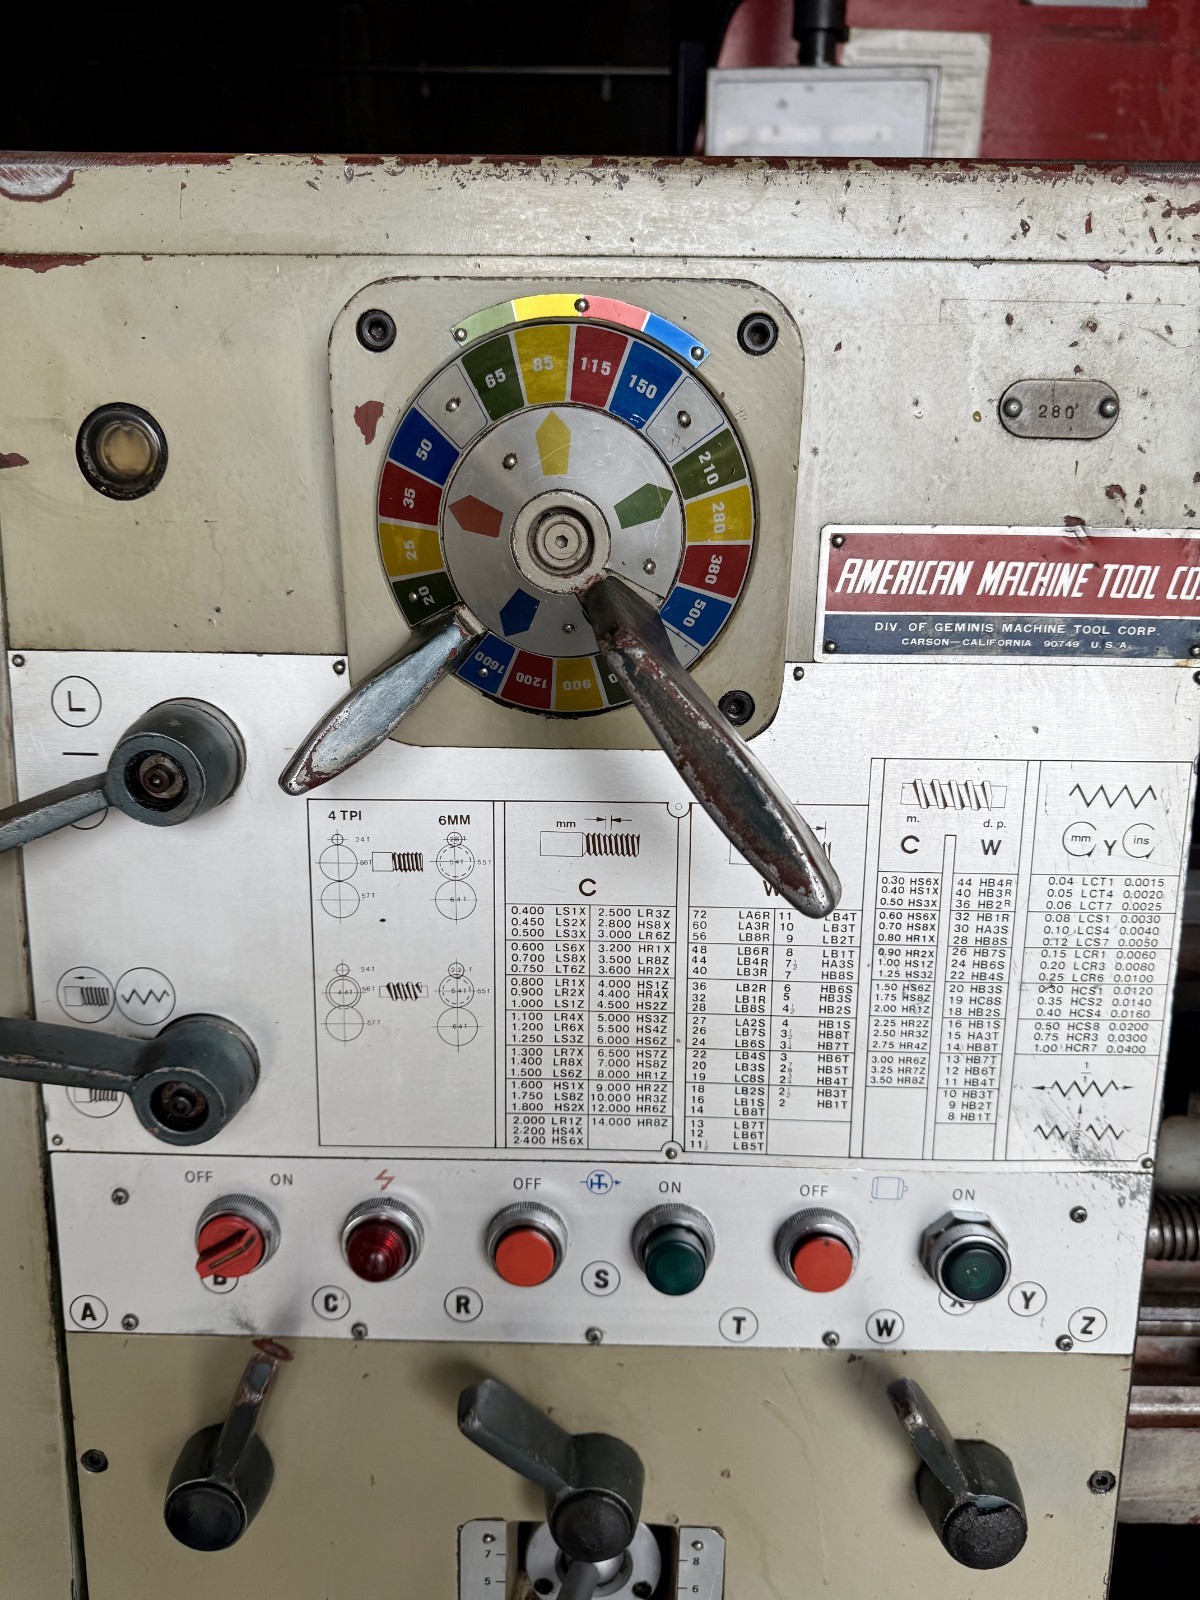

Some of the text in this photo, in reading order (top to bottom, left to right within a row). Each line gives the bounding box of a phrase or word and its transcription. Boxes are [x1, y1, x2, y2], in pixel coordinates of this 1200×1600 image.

[533, 356, 554, 371] 85
[581, 357, 612, 376] 115
[485, 369, 506, 388] 65
[628, 374, 658, 399] 150
[1038, 404, 1074, 419] 280
[416, 438, 433, 462] 50
[699, 451, 719, 486] 210
[403, 488, 416, 509] 35
[712, 501, 725, 534] 280
[403, 540, 417, 560] 25
[705, 554, 722, 584] 380
[834, 558, 975, 595] AMERICAN
[976, 561, 1094, 597] MACHINE
[1097, 564, 1160, 599] TOOL
[418, 586, 435, 606] 20
[683, 598, 706, 627] 500
[875, 622, 1160, 635] DIV. OF GEMINIS MACHINE TOOL CORP.
[474, 651, 506, 674] 1600
[516, 672, 547, 689] 1200
[563, 679, 591, 690] 900
[68, 690, 86, 712] L
[328, 811, 362, 821] 4 TPI
[439, 815, 470, 825] 6MM
[556, 820, 576, 828] mm
[901, 835, 920, 854] C
[1133, 835, 1149, 845] ins
[981, 839, 1002, 855] W
[1104, 840, 1117, 856] Y
[882, 877, 905, 885] 0.30
[980, 879, 1012, 887] HB4R
[1048, 876, 1164, 887] 0.04 LCT1 0.0015
[578, 878, 597, 897] C
[511, 907, 586, 915] 0.400 LS1X
[599, 909, 670, 918] 2.500 LR3Z
[739, 911, 770, 920] LA6R
[955, 913, 1009, 922] 32 HB1R
[1045, 914, 1160, 923] 0.08 LCS1 0.0030
[780, 923, 855, 932] 10 LB3T
[879, 922, 936, 931] 0.70 HS8X
[511, 929, 586, 938] 0.500 LS3X
[598, 931, 670, 940] 3.000 LR6Z
[512, 954, 586, 962] 0.700 LS8X
[786, 948, 855, 958] 8 LB1T
[692, 956, 768, 966] 44 LB4R
[951, 959, 1005, 969] 24 HB6S
[1040, 961, 1155, 971] 0.20 LCR3 0.0080
[511, 978, 585, 987] 0.800 LR1X
[599, 980, 668, 989] 4.000 HS1Z
[737, 984, 766, 992] LB2R
[1036, 1008, 1150, 1018] 0.40 HCS4 0.0160
[512, 1023, 543, 1031] 1.200
[692, 1017, 765, 1027] 27 LA2S
[782, 1019, 850, 1028] 4 HB1S
[874, 1019, 896, 1027] 2.25
[597, 1025, 667, 1033] 5.500 HS4Z
[1033, 1033, 1147, 1042] 0.75 HCR3 0.0300
[553, 1058, 583, 1066] LR8X
[780, 1053, 849, 1063] 3 HB6T
[599, 1059, 667, 1068] 7.000 HS8Z
[871, 1066, 892, 1074] 3.25
[965, 1067, 995, 1075] HB6T
[944, 1090, 993, 1098] 10 HB3T
[817, 1100, 848, 1109] HB1T
[514, 1116, 582, 1125] 2.000 LR1Z
[592, 1118, 668, 1127] 14.000 HR8Z
[691, 1120, 765, 1129] 13 LB7T
[184, 1170, 213, 1183] OFF
[270, 1174, 293, 1186] ON
[513, 1177, 541, 1190] OFF
[658, 1180, 682, 1193] ON
[799, 1184, 829, 1197] OFF
[952, 1188, 975, 1201] ON
[594, 1269, 610, 1289] S
[323, 1294, 339, 1313] C
[455, 1294, 471, 1314] R
[1021, 1291, 1037, 1309] Y
[81, 1302, 97, 1321] A
[732, 1316, 746, 1335] T
[875, 1318, 897, 1337] W
[1080, 1316, 1096, 1335] Z
[484, 1550, 491, 1558] 7
[692, 1557, 700, 1566] 8
[484, 1577, 491, 1586] 5
[692, 1584, 699, 1592] 6
